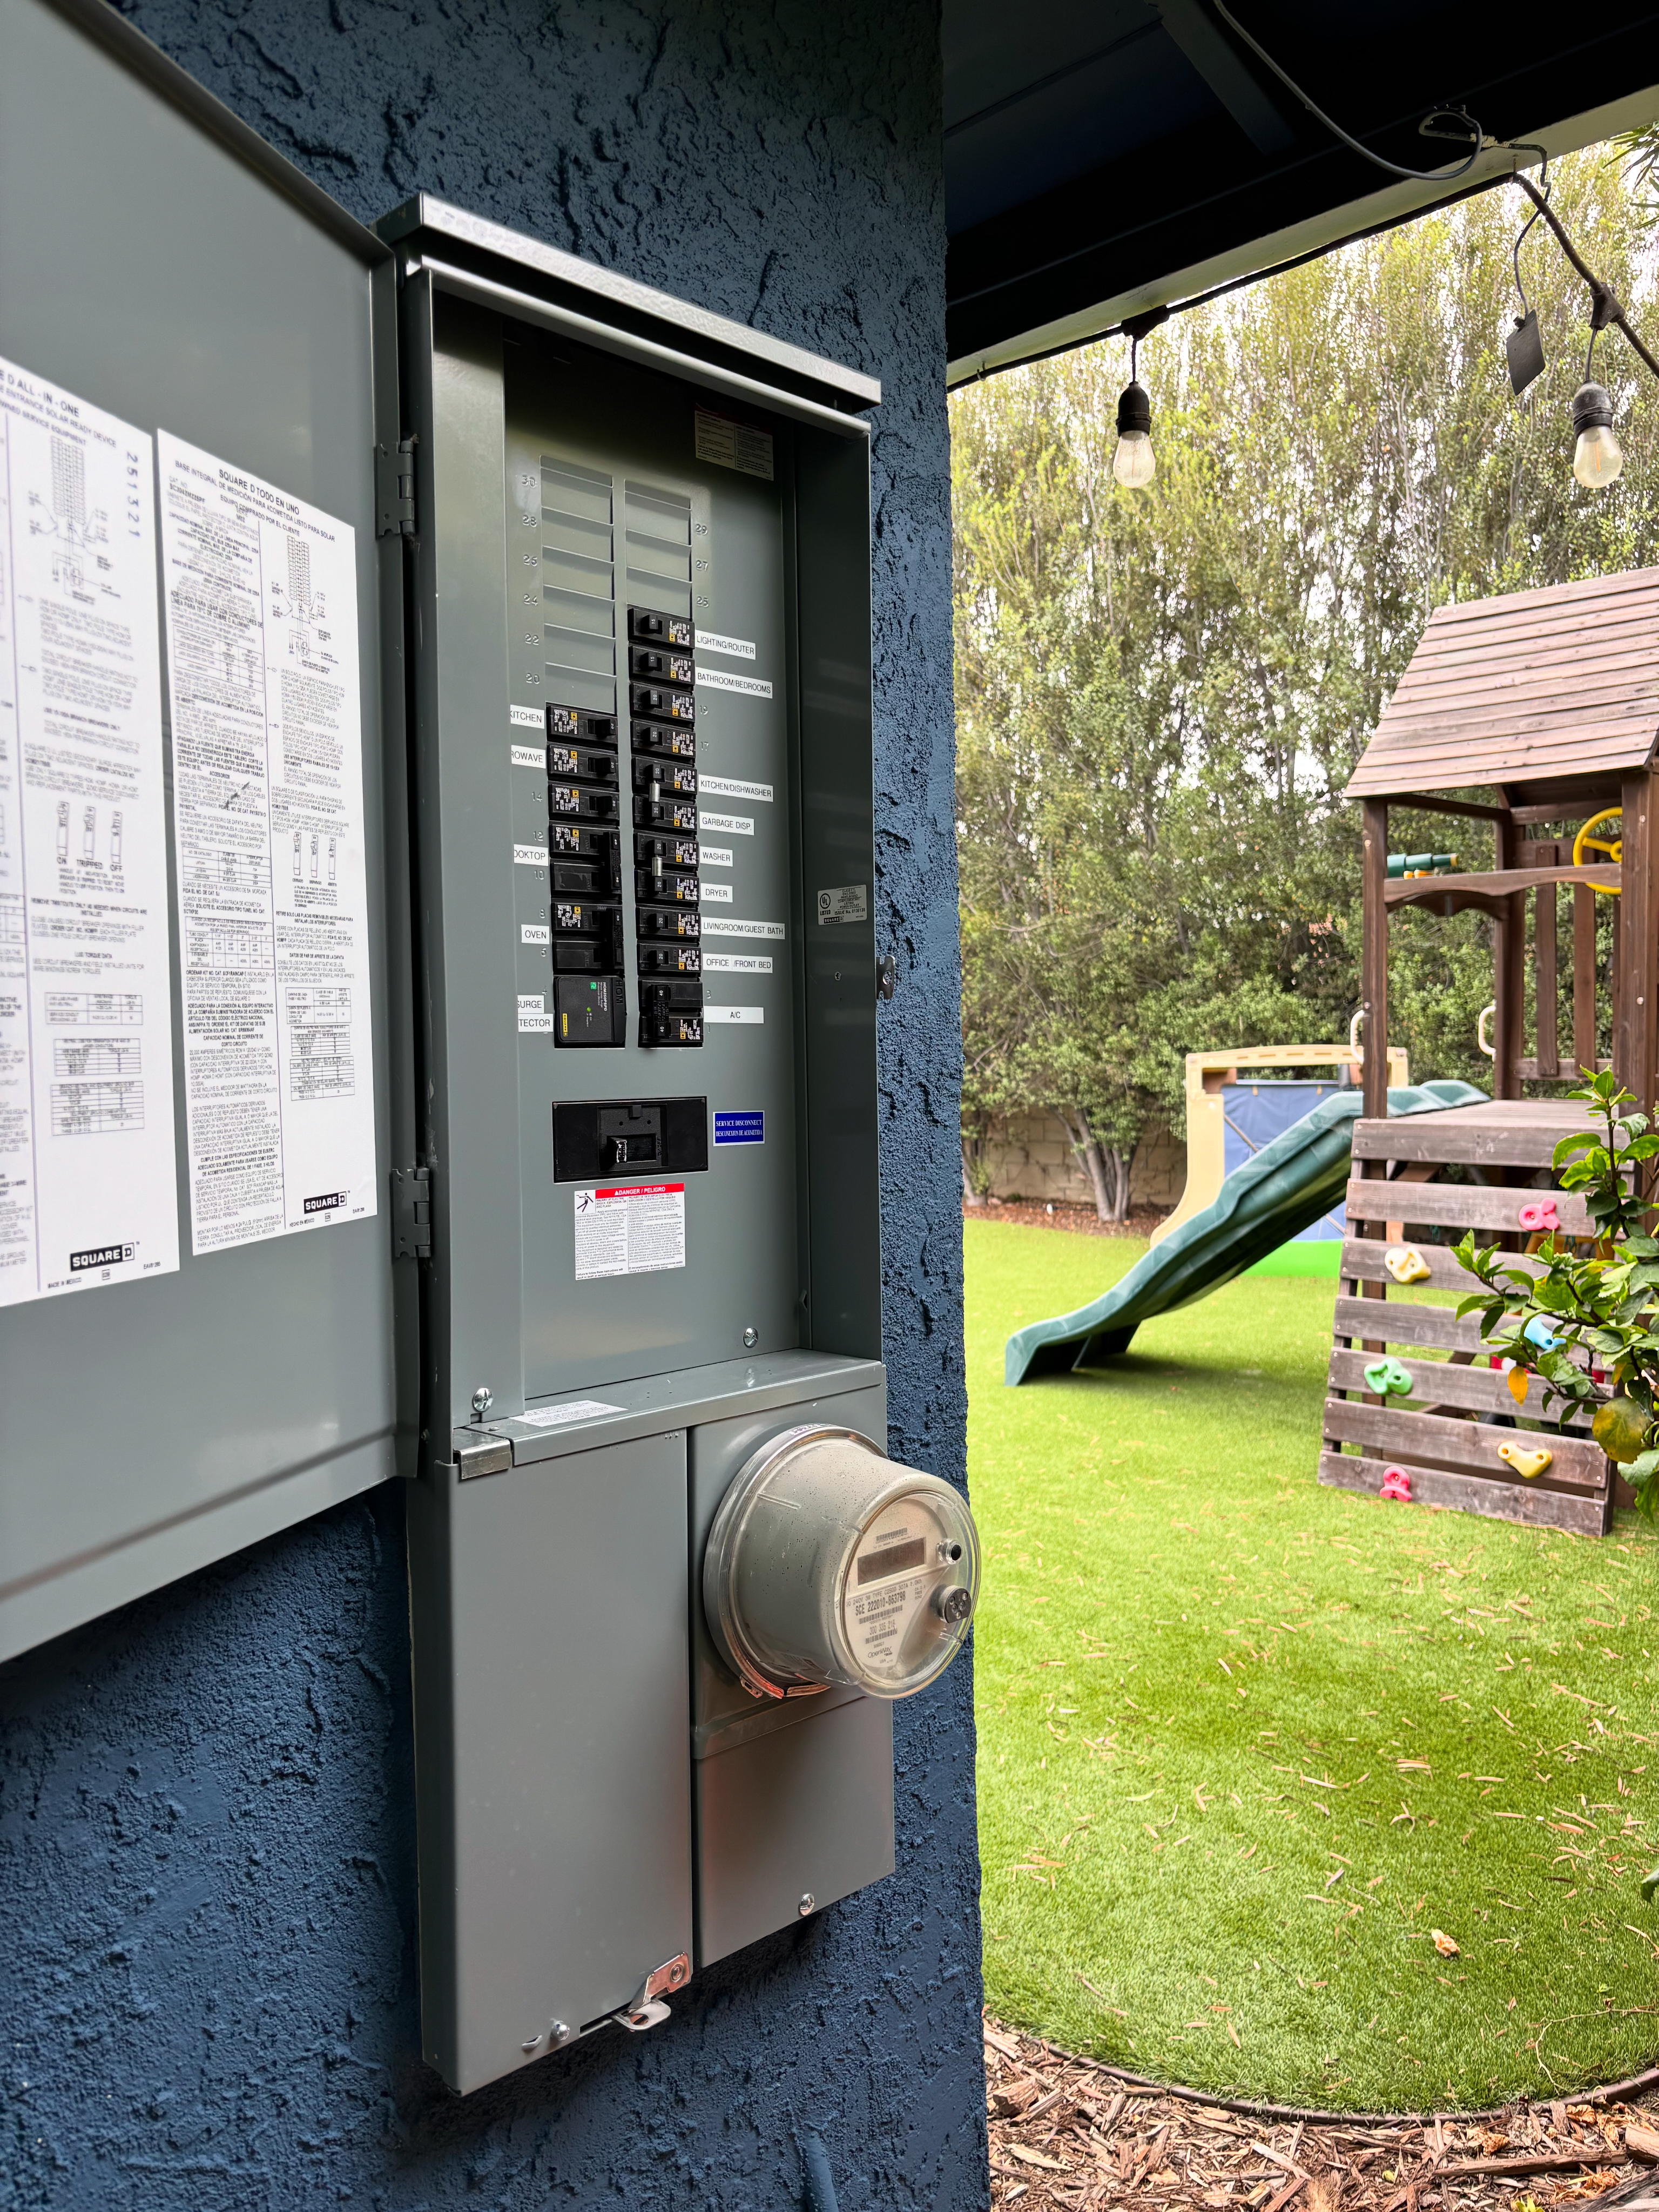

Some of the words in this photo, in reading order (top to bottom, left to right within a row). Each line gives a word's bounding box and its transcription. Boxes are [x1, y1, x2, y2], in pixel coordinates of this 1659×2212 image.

[8, 374, 14, 385] D
[17, 378, 35, 396] ALL
[43, 392, 52, 404] IN
[60, 400, 80, 418] ONE
[5, 387, 44, 413] ENTRANCE
[45, 407, 69, 424] SOLAR
[70, 419, 91, 435] READY
[93, 430, 117, 448] DEVICE
[219, 469, 248, 490] SQUARE
[251, 484, 255, 493] D
[257, 487, 274, 503] TODO
[276, 497, 285, 508] EN
[286, 503, 299, 515] UNO
[175, 460, 190, 473] BASE
[192, 468, 217, 486] INTEGRAL
[219, 481, 226, 490] DE
[227, 485, 252, 502] MEDICIÓN
[253, 497, 266, 509] PARA
[267, 504, 293, 522] ACOMETIDA
[294, 518, 307, 529] LISTO
[308, 524, 320, 535] PARA
[321, 530, 335, 542] SOLAR
[266, 516, 275, 524] POR
[276, 520, 281, 528] EL
[282, 523, 300, 537] CLIENTE
[695, 524, 708, 535] 29
[696, 559, 709, 571] 27
[523, 594, 538, 606] 24
[525, 633, 539, 645] 22
[697, 636, 754, 655] LIGHTING/ROUTER
[526, 673, 540, 684] 20
[698, 673, 771, 693] BATHROOM/BEDROOMS
[700, 705, 708, 715] 19
[700, 741, 710, 752] 17
[701, 780, 771, 797] KITCHEN/DISHWASHER
[531, 792, 543, 802] 14
[703, 817, 733, 828] GARBAGE
[736, 821, 752, 831] DISP.
[534, 831, 544, 841] 12
[703, 852, 730, 861] WASHER
[77, 859, 104, 870] TRIPPED
[110, 864, 123, 872] OFF
[534, 871, 544, 880] 10
[705, 889, 727, 898] DRYER
[704, 922, 765, 934] LIVINGROOM/GUEST
[525, 930, 547, 939] OVEN
[518, 1019, 550, 1027] TECTOR
[305, 1196, 338, 1210] SQUARE
[340, 1195, 345, 1203] D
[72, 1249, 120, 1267] SQUARE
[124, 1247, 132, 1257] D
[66, 1277, 82, 1285] MEXICO
[855, 1604, 865, 1616] SCE
[868, 1647, 892, 1658] OpenWay
